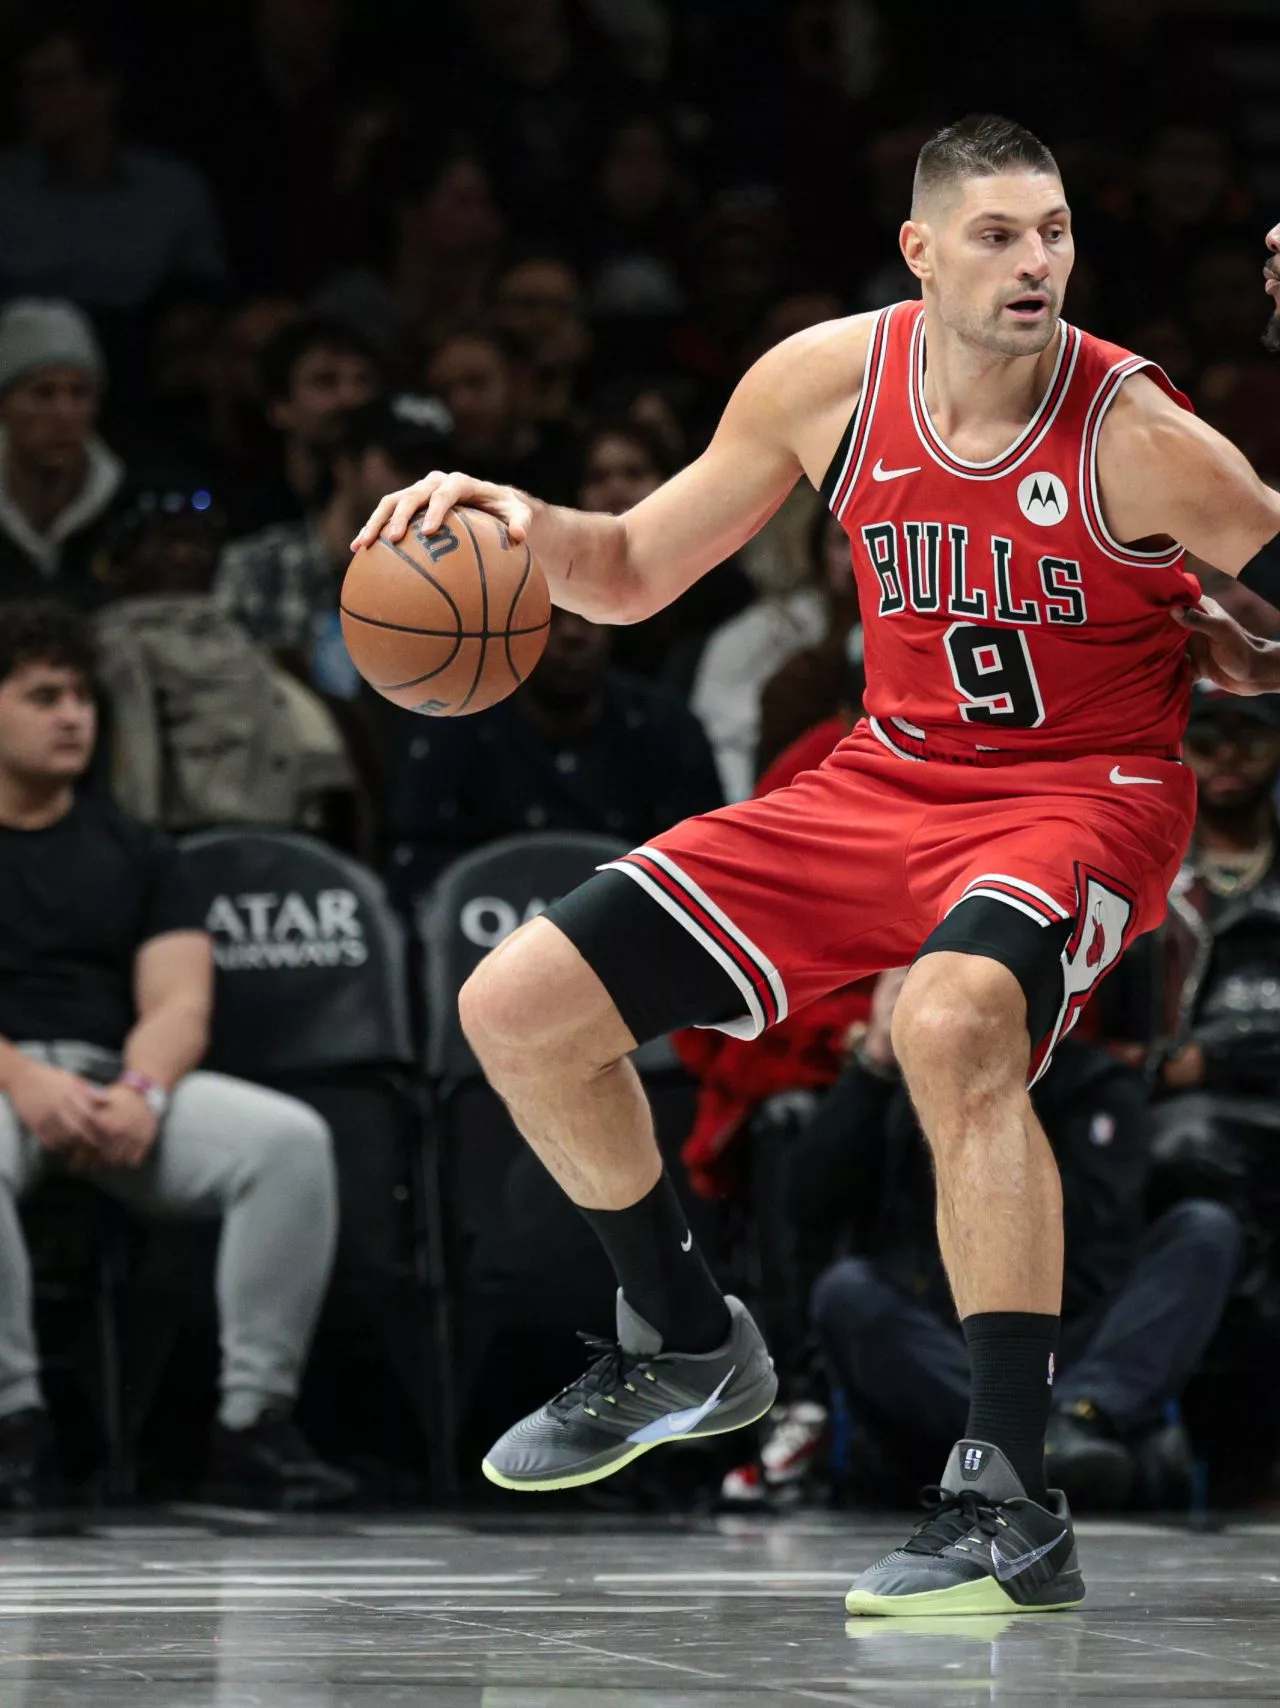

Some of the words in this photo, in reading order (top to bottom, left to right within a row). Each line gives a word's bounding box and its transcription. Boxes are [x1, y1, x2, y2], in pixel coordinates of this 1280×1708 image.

[861, 520, 1088, 627] BULLS
[942, 620, 1046, 729] 9
[204, 889, 362, 942] ATAR
